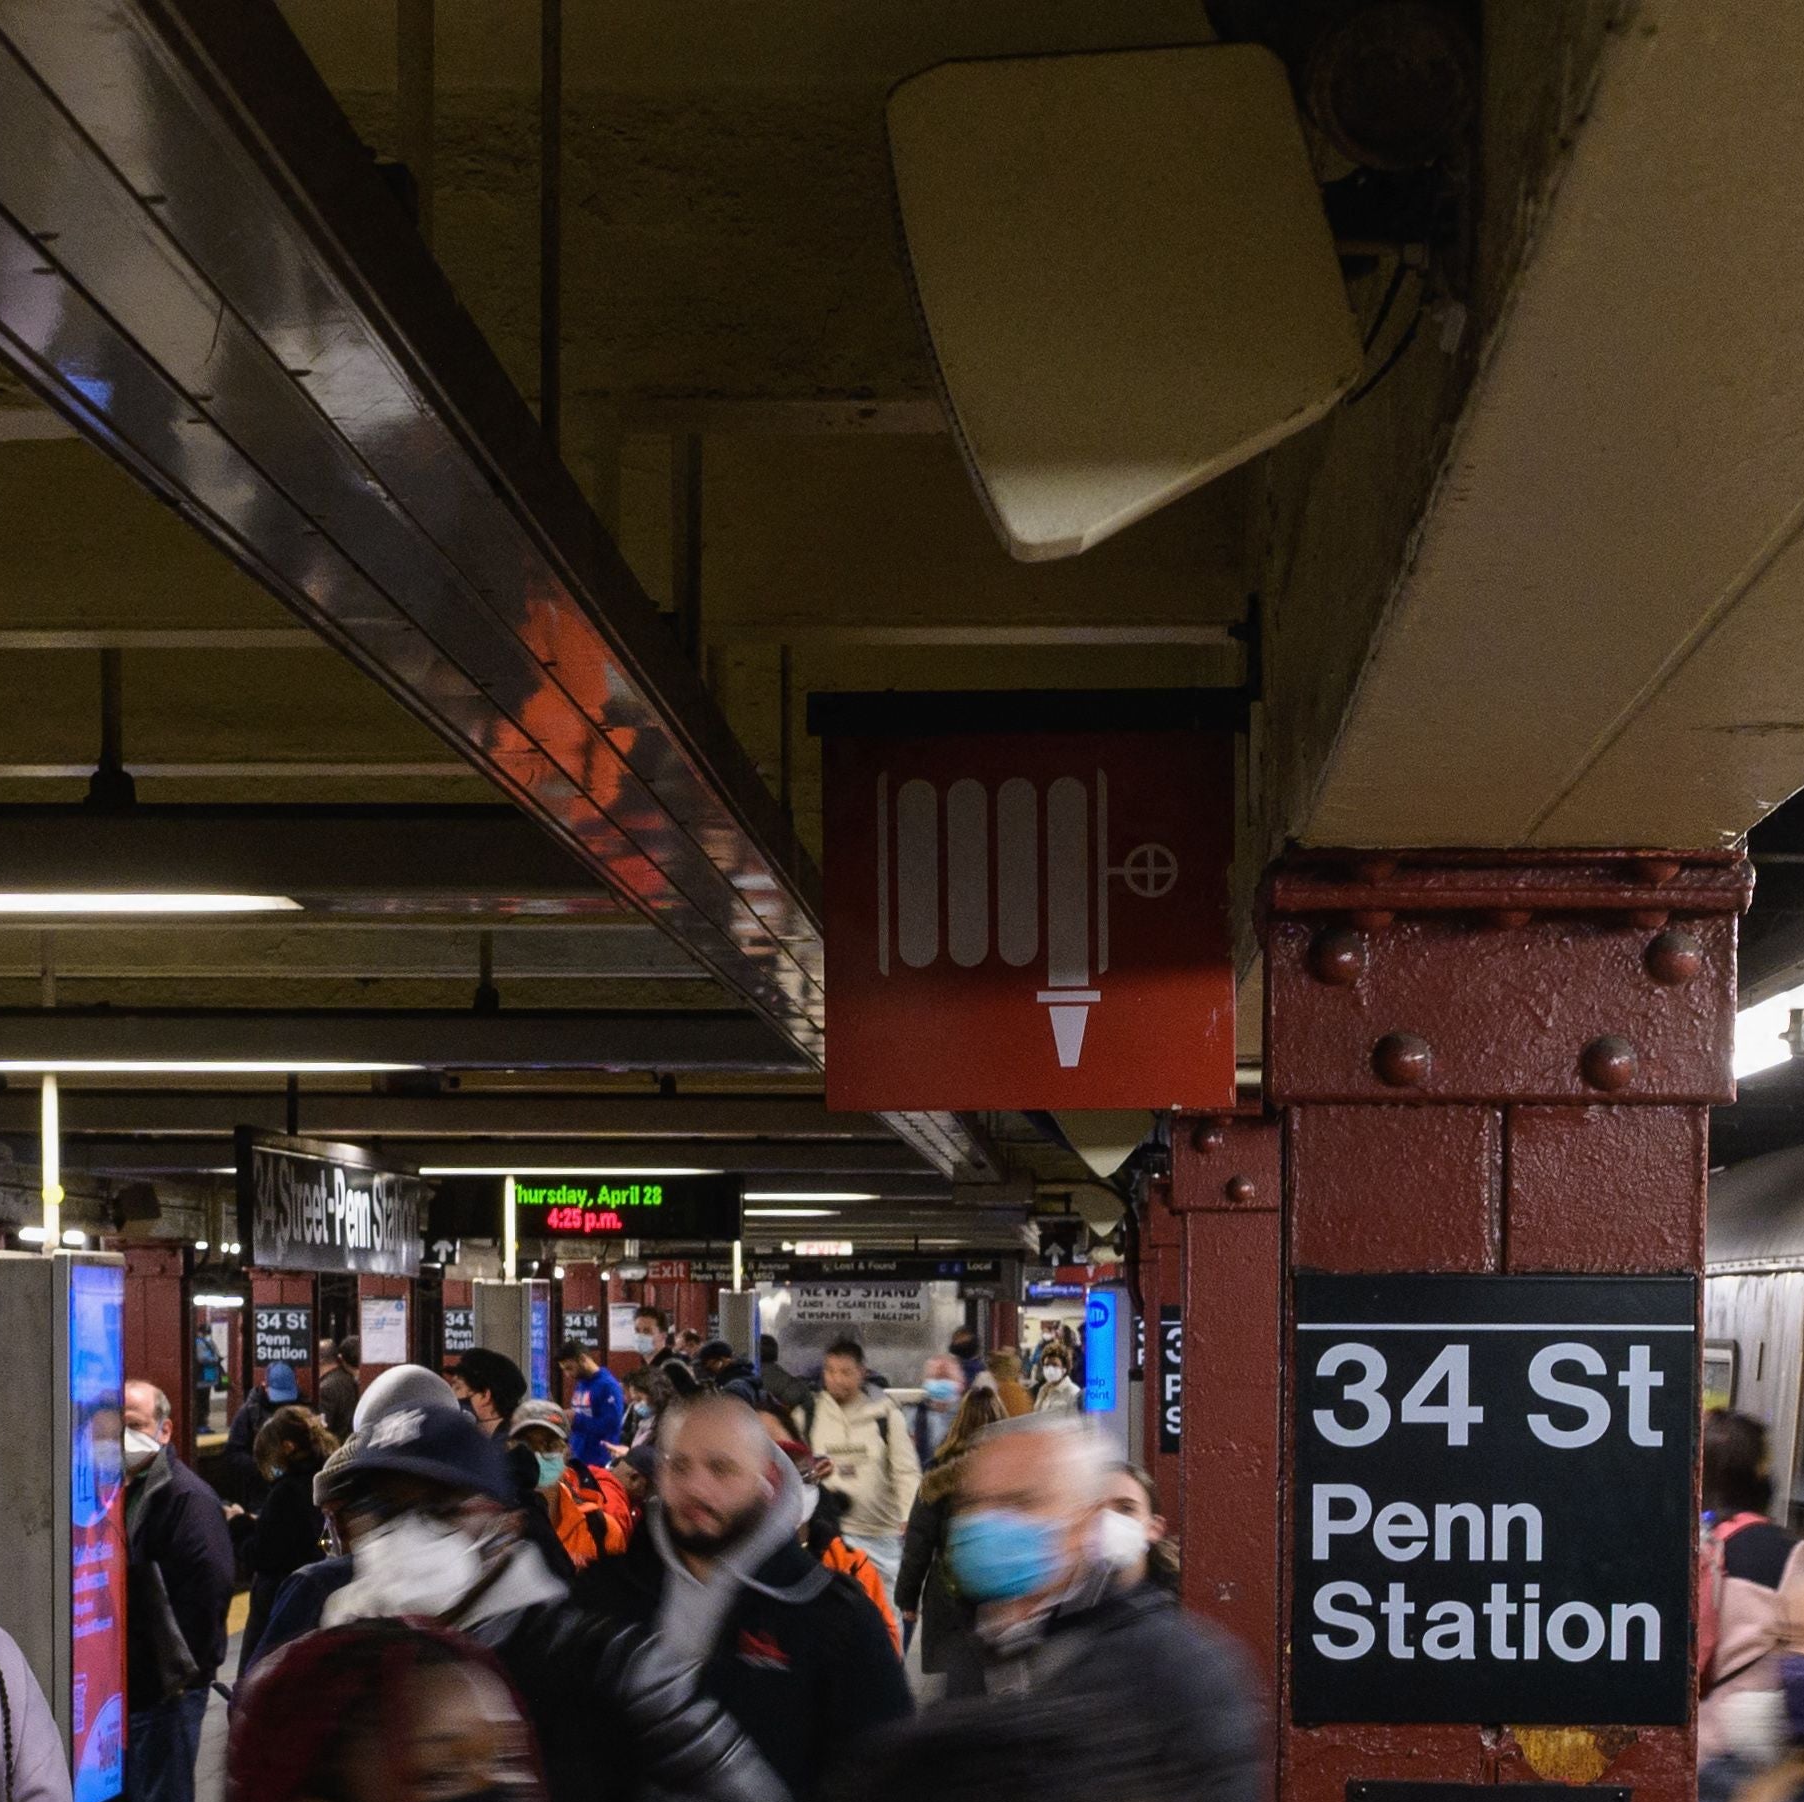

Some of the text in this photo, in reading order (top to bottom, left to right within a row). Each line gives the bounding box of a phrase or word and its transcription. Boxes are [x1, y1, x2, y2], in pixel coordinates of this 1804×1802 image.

[515, 1184, 663, 1209] hursday, April 28
[372, 1172, 418, 1251] Station
[548, 1207, 622, 1233] 4:25 p.m.
[648, 1261, 686, 1279] Exit
[868, 1261, 896, 1271] Found
[966, 1261, 993, 1271] Local
[257, 1312, 308, 1330] 34 St
[445, 1312, 465, 1326] 34
[565, 1315, 598, 1327] 34 St
[257, 1333, 291, 1346] Penn
[257, 1347, 308, 1360] Station
[1313, 1342, 1664, 1449] 34 St
[1311, 1482, 1544, 1563] Penn
[1311, 1581, 1663, 1663] Station
